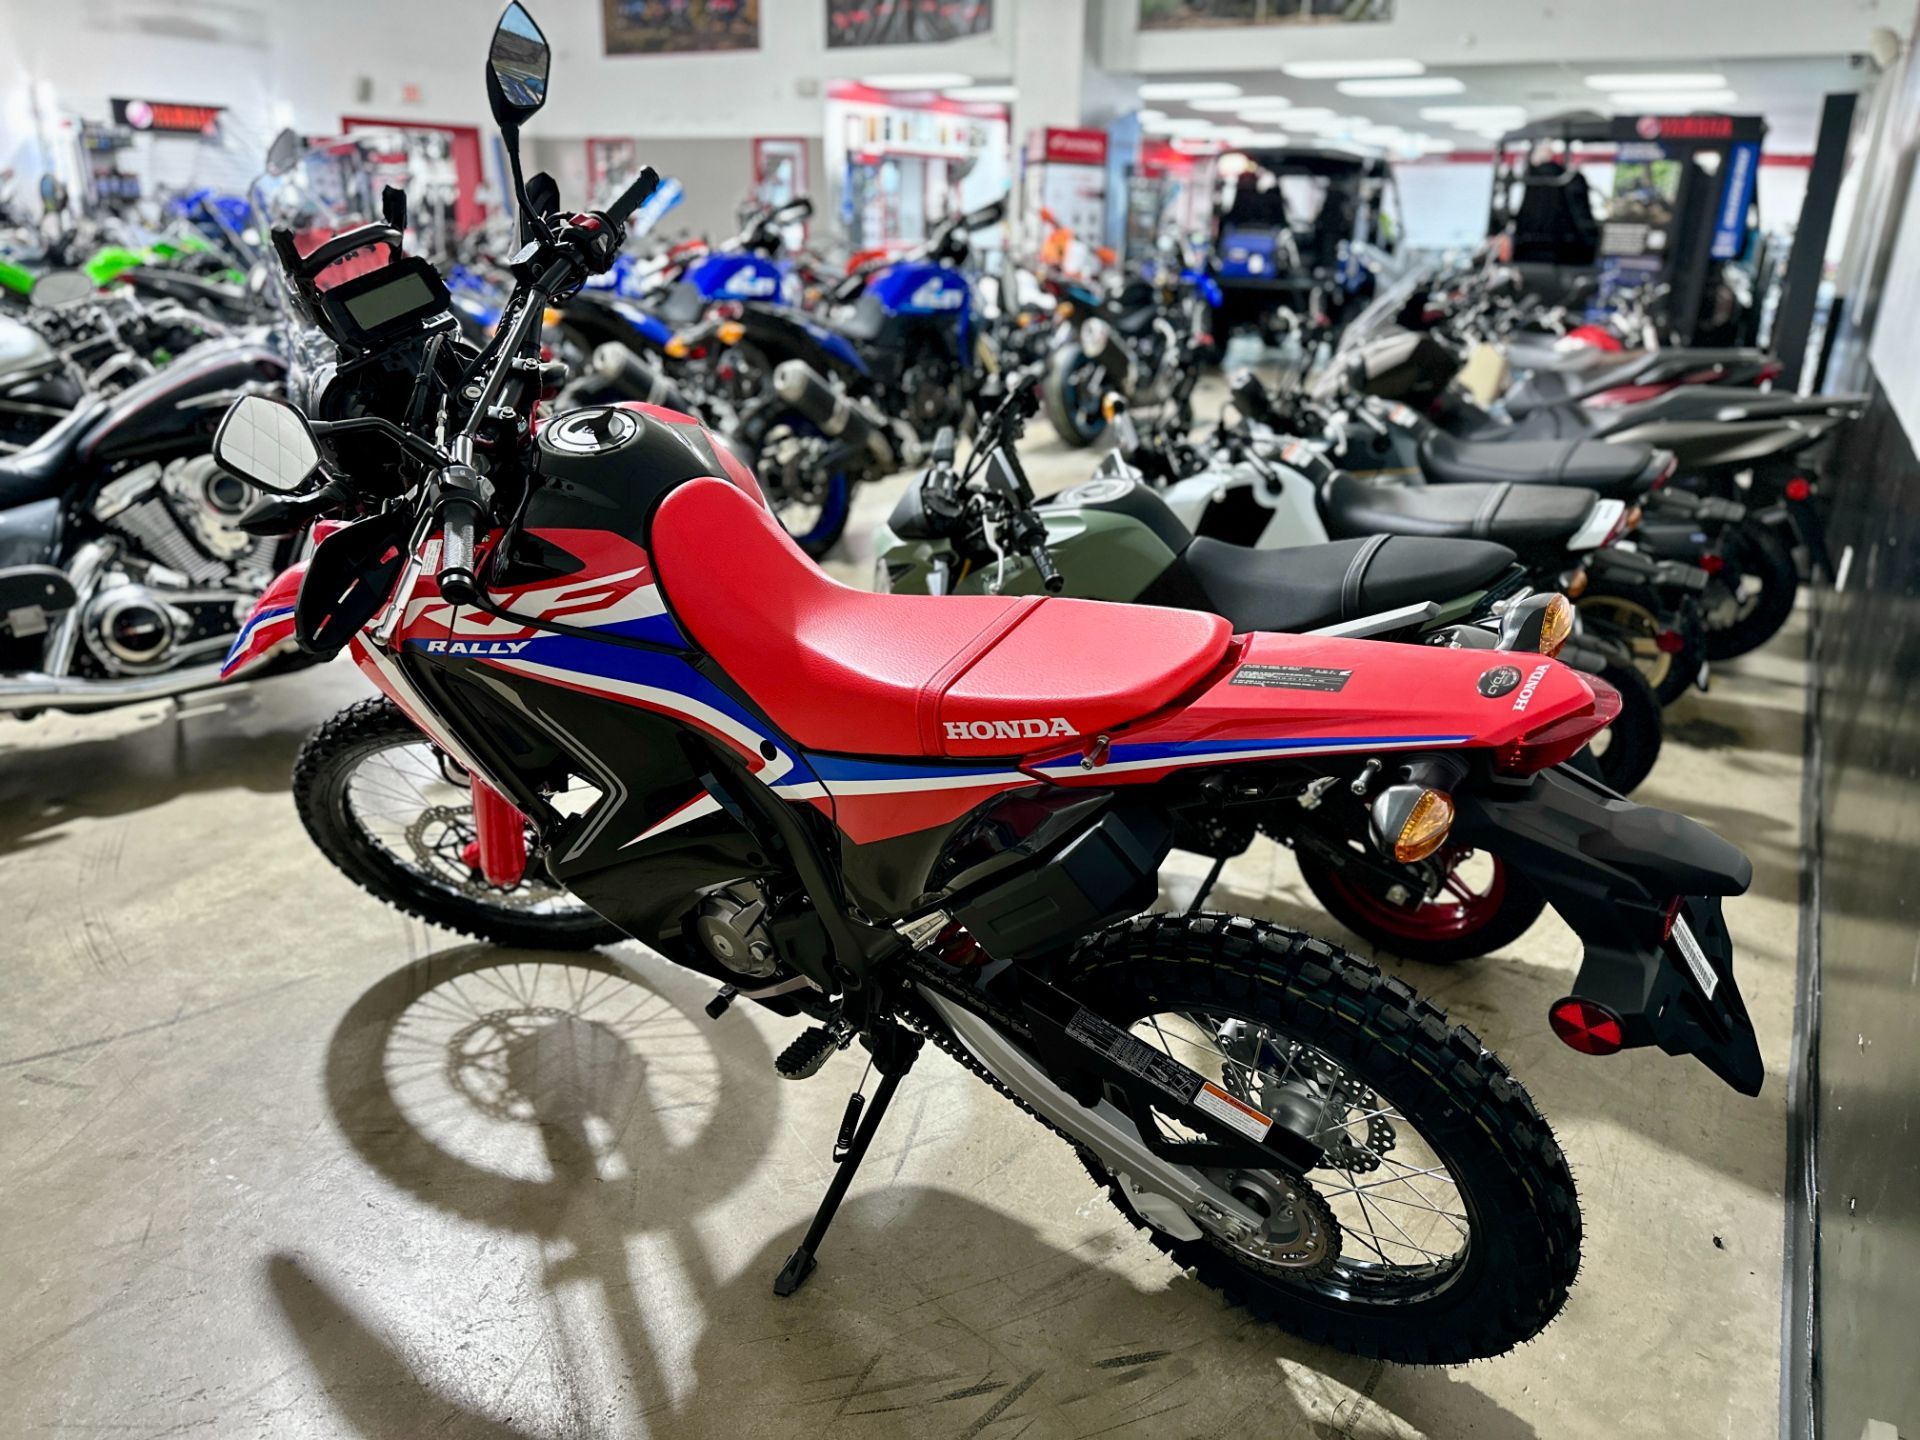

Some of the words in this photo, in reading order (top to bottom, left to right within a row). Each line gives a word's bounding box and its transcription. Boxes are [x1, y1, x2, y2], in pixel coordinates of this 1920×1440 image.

[427, 640, 531, 654] RALLY
[1512, 664, 1551, 711] HONDA
[943, 717, 1081, 740] HONDA
